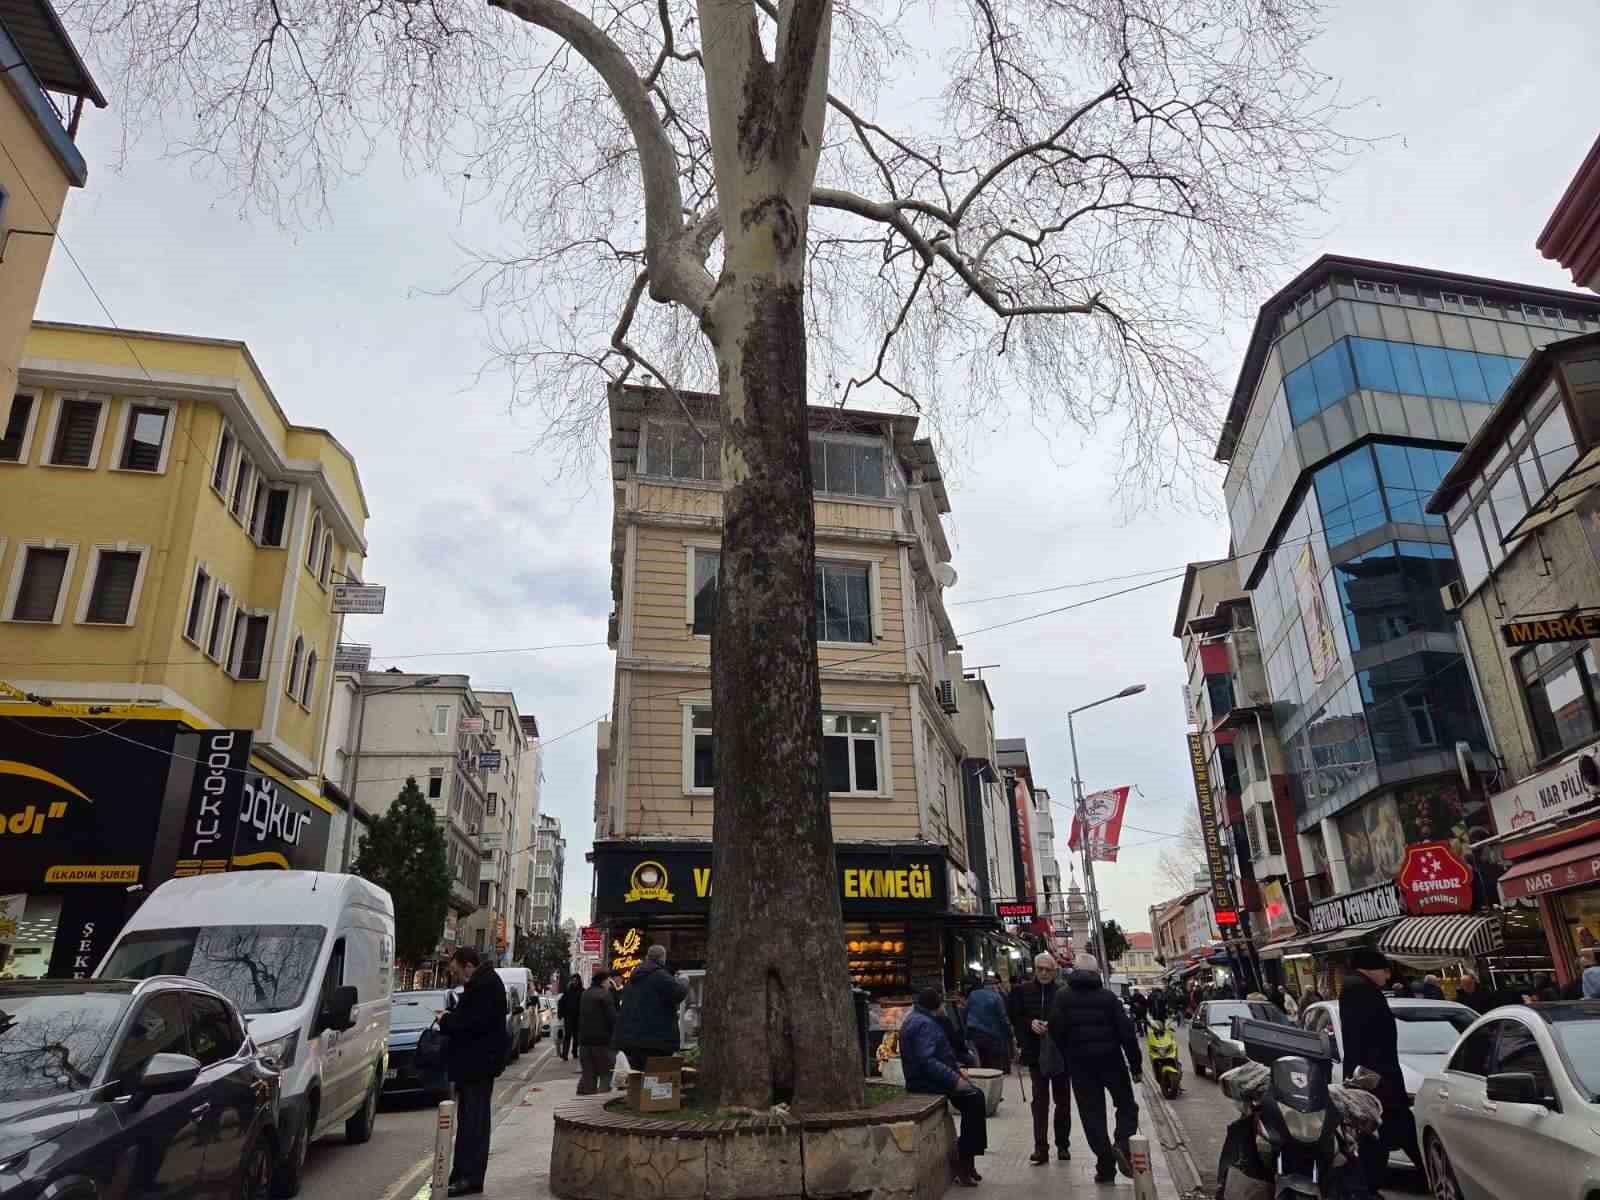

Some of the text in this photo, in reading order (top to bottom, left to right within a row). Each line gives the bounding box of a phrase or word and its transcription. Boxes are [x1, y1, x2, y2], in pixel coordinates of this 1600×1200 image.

[1511, 616, 1600, 641] MARKE
[193, 731, 235, 855] doğkur
[1538, 785, 1561, 808] NAR
[1205, 820, 1224, 879] TELEFONU
[844, 864, 932, 898] EKMEĞİ
[1525, 873, 1553, 893] NAR
[1215, 885, 1229, 906] CEP
